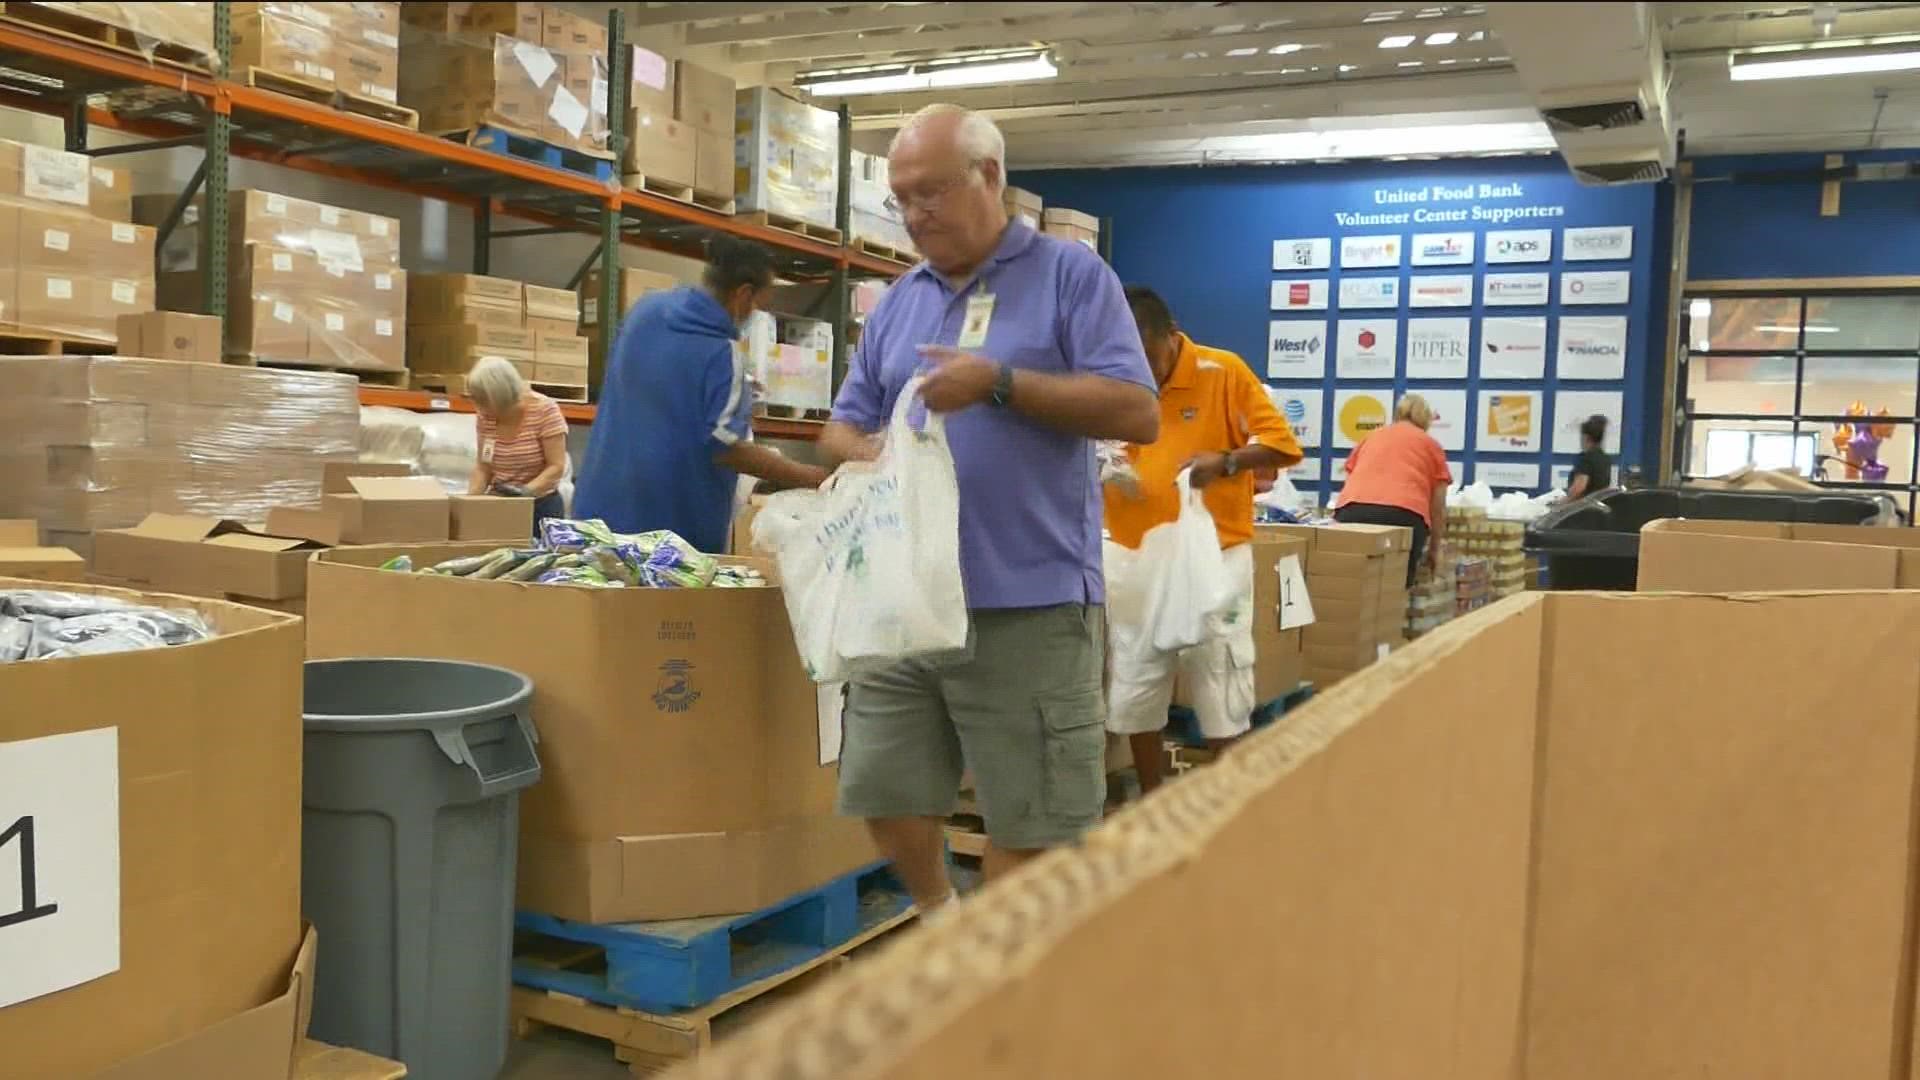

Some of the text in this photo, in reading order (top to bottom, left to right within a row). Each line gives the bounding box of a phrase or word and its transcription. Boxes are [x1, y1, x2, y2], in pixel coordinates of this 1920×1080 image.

[1375, 183, 1523, 204] United Food Bank
[1335, 205, 1564, 226] Volunteer Center Supporters
[1513, 239, 1539, 252] aps
[1273, 337, 1308, 352] West
[1411, 340, 1465, 358] PIPER
[0, 815, 58, 928] 1
